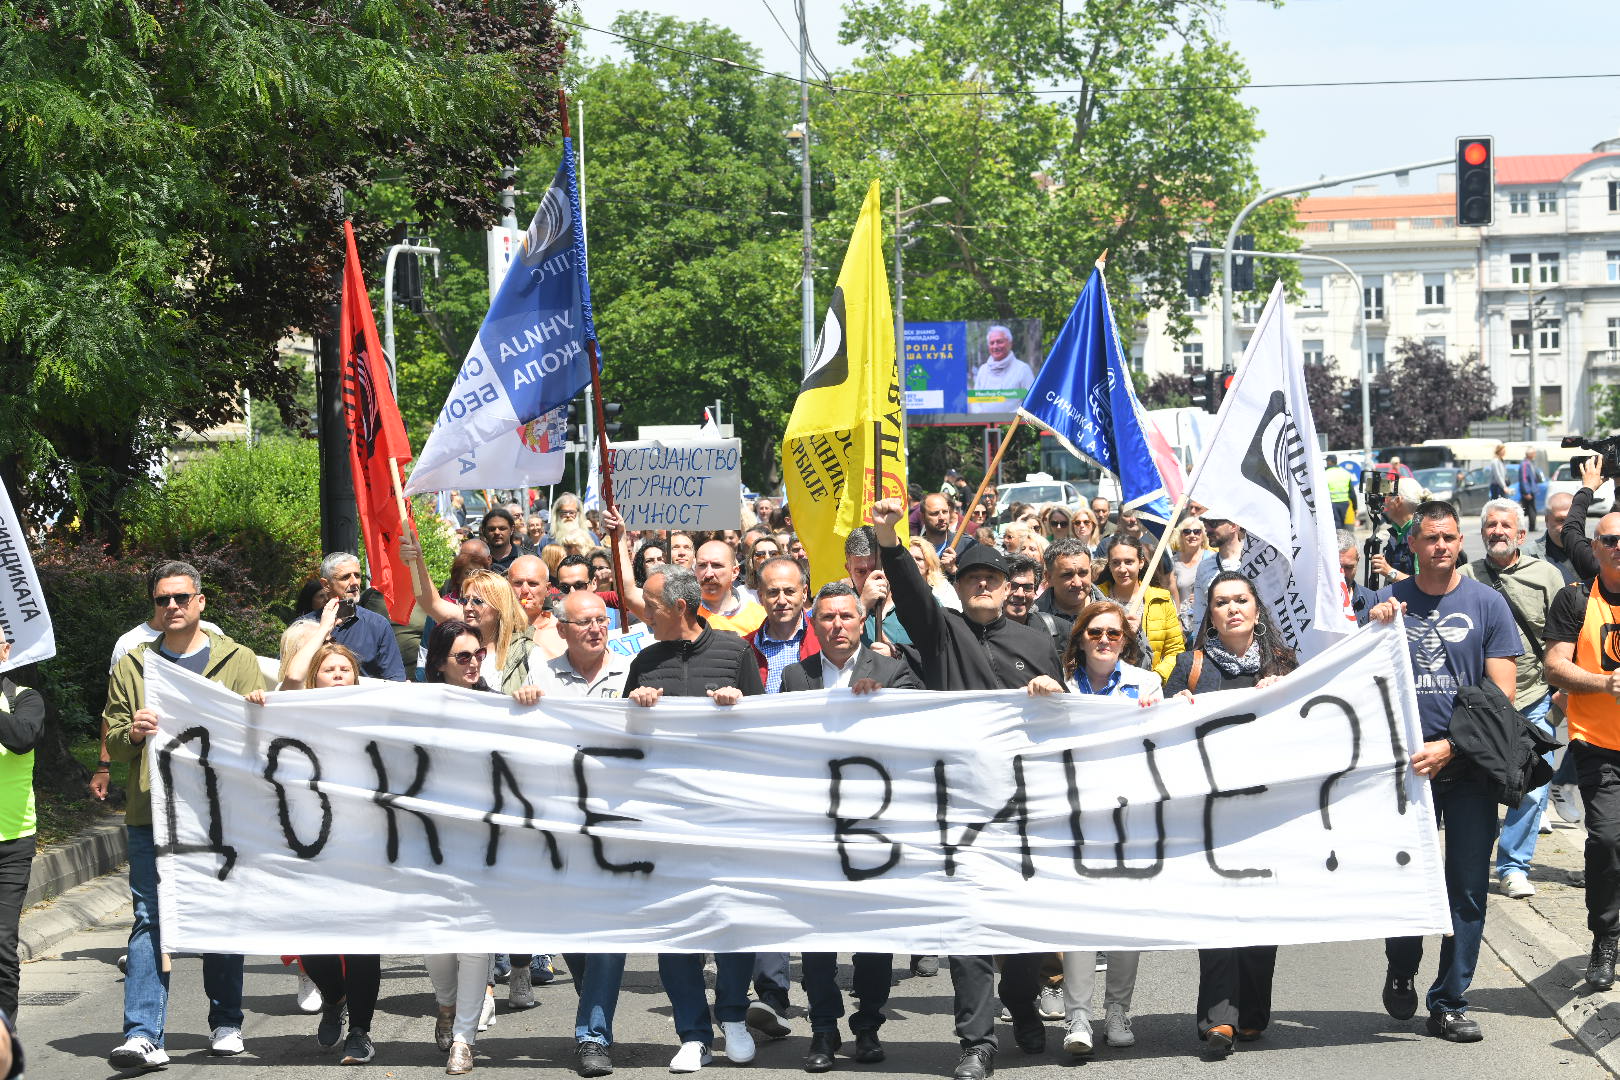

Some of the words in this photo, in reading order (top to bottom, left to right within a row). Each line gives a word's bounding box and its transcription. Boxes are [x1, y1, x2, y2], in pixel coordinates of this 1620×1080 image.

[906, 344, 937, 352] РОПА
[942, 343, 954, 351] ЈЕ
[906, 352, 922, 360] ША
[926, 351, 954, 360] КУЋА
[1045, 390, 1100, 436] СИНДИКАТ
[612, 502, 709, 526] ИЧНОСТ
[154, 725, 656, 882] ДОКЛЕ
[827, 675, 1410, 882] ВИШЕ?!
